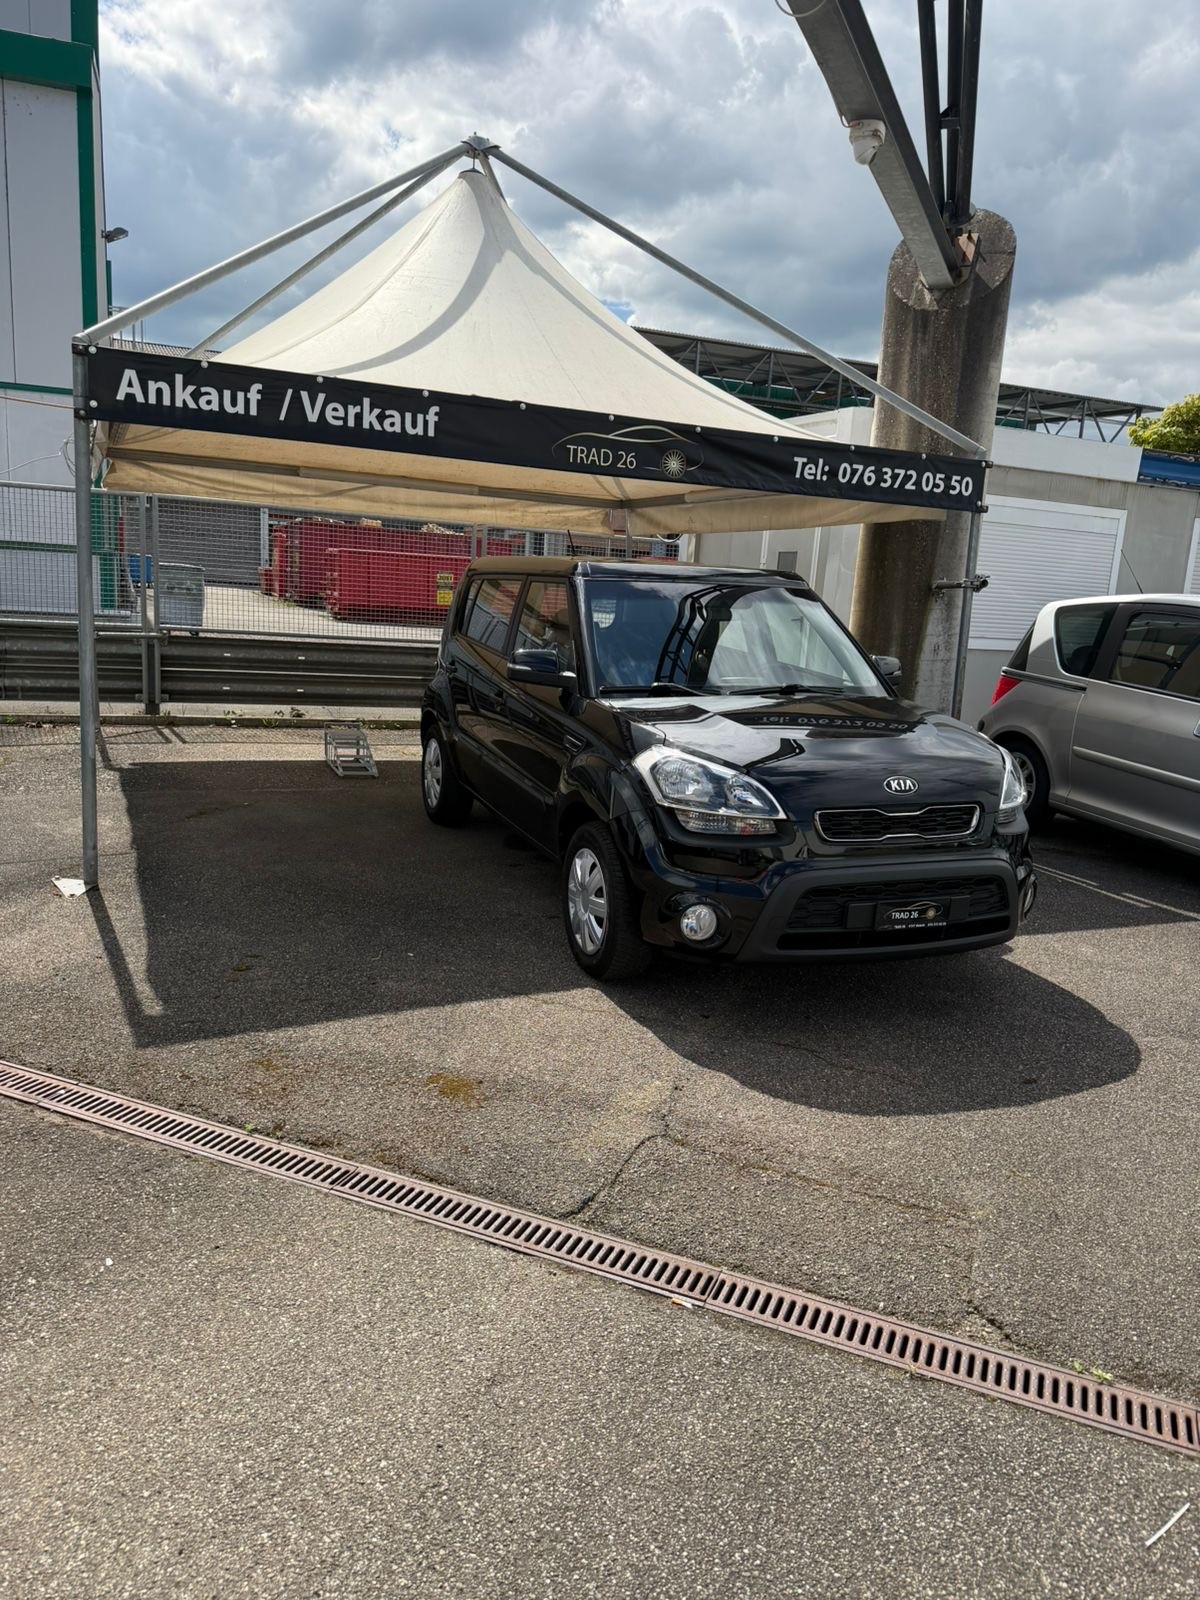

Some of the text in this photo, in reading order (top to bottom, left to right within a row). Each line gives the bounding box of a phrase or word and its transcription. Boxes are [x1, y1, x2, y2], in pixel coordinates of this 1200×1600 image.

[116, 368, 263, 416] Ankauf
[566, 444, 637, 470] TRAD 26
[794, 456, 973, 497] Tel: 076 372 05 50
[889, 779, 914, 791] KIA
